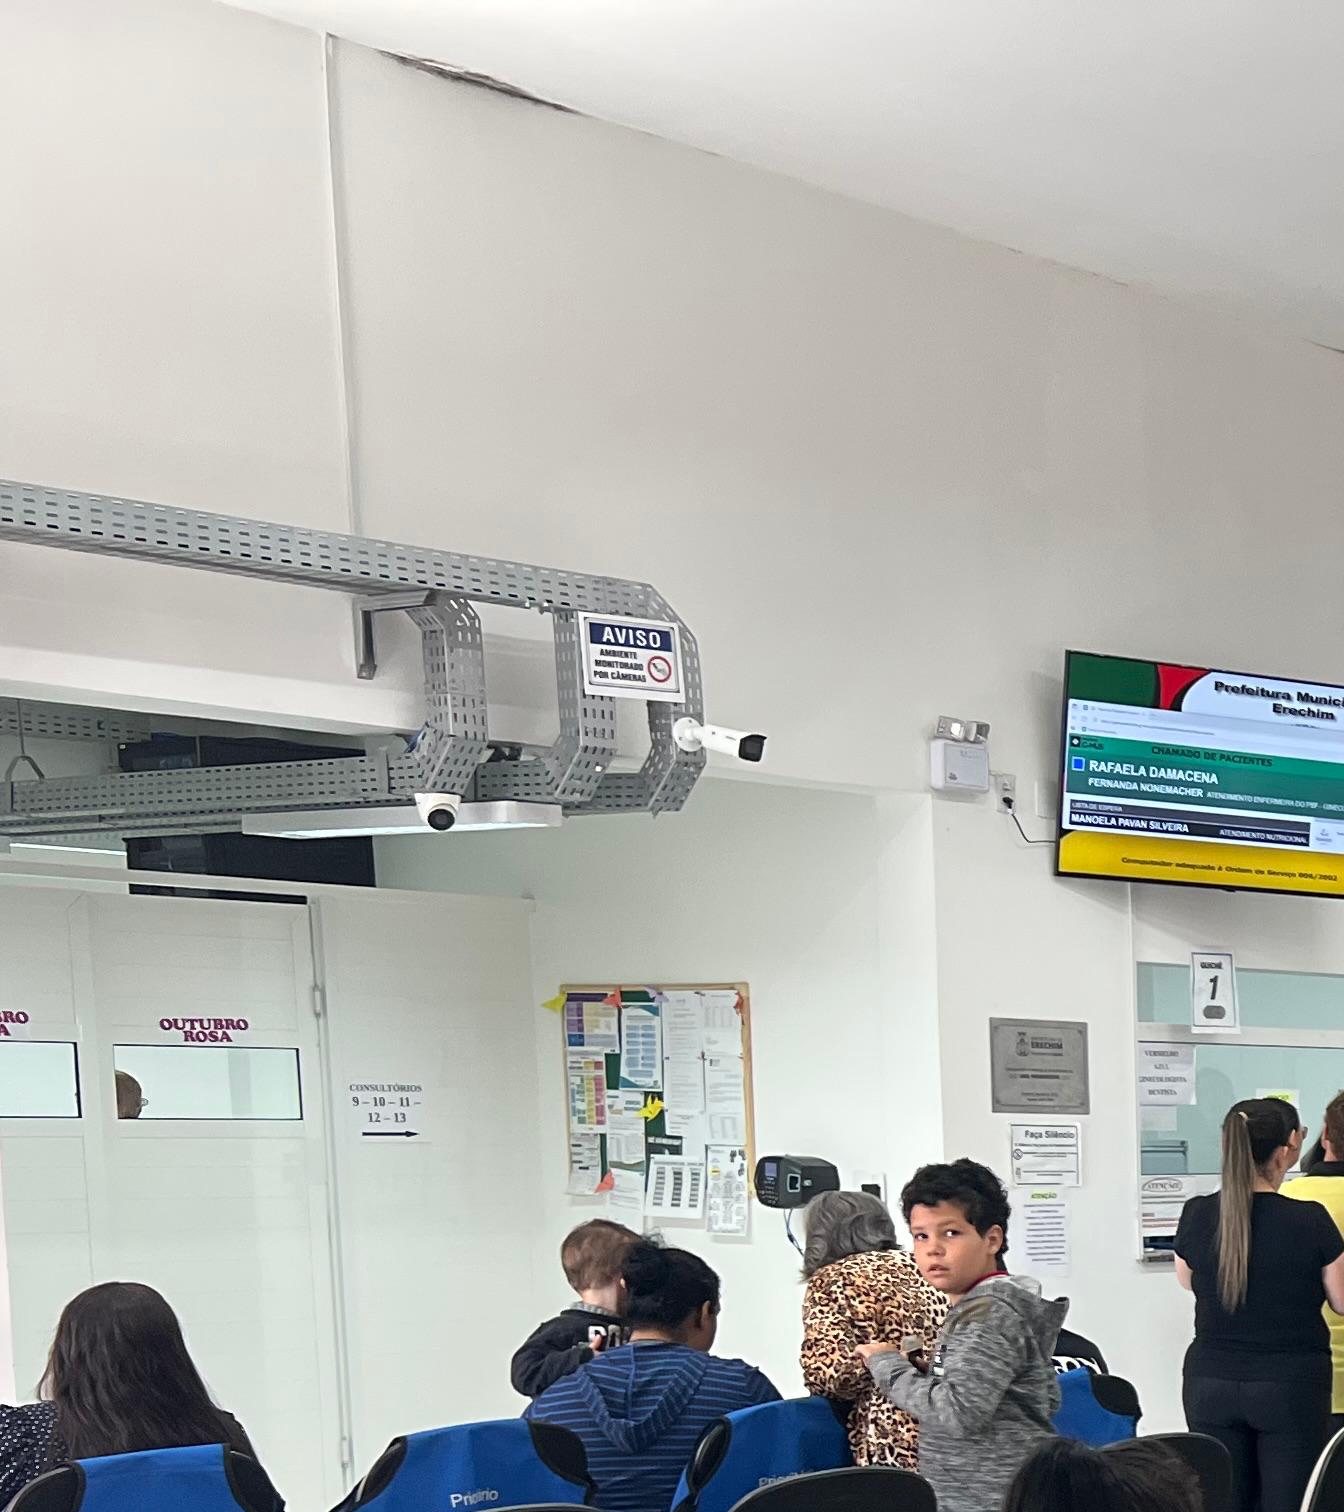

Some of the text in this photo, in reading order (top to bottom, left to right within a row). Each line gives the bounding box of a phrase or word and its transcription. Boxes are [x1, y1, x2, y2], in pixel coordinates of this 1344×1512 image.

[602, 626, 661, 648] AVISO
[600, 649, 637, 659] AMBIENTE
[595, 660, 644, 671] MONITORADO
[594, 671, 647, 682] POR CÂMERAS
[1215, 681, 1291, 701] Prefeitura
[1273, 704, 1335, 720] Erechim
[1152, 746, 1273, 767] CHAMADO DE PACIENTES
[1089, 760, 1218, 784] RAFAELA DAMACENA
[1088, 778, 1203, 797] FERNANDA NONEMACHER
[1071, 814, 1189, 832] MANOELA PAVAN SILVEIRA
[1210, 976, 1218, 1000] 1
[160, 1018, 248, 1030] OUTUBRO
[184, 1031, 232, 1042] ROSA
[350, 1082, 422, 1092] CONSULTÓRIOS
[352, 1097, 409, 1107] 9 10 11
[369, 1113, 406, 1122] 12 13
[1025, 1130, 1075, 1139] Faça Silêncio
